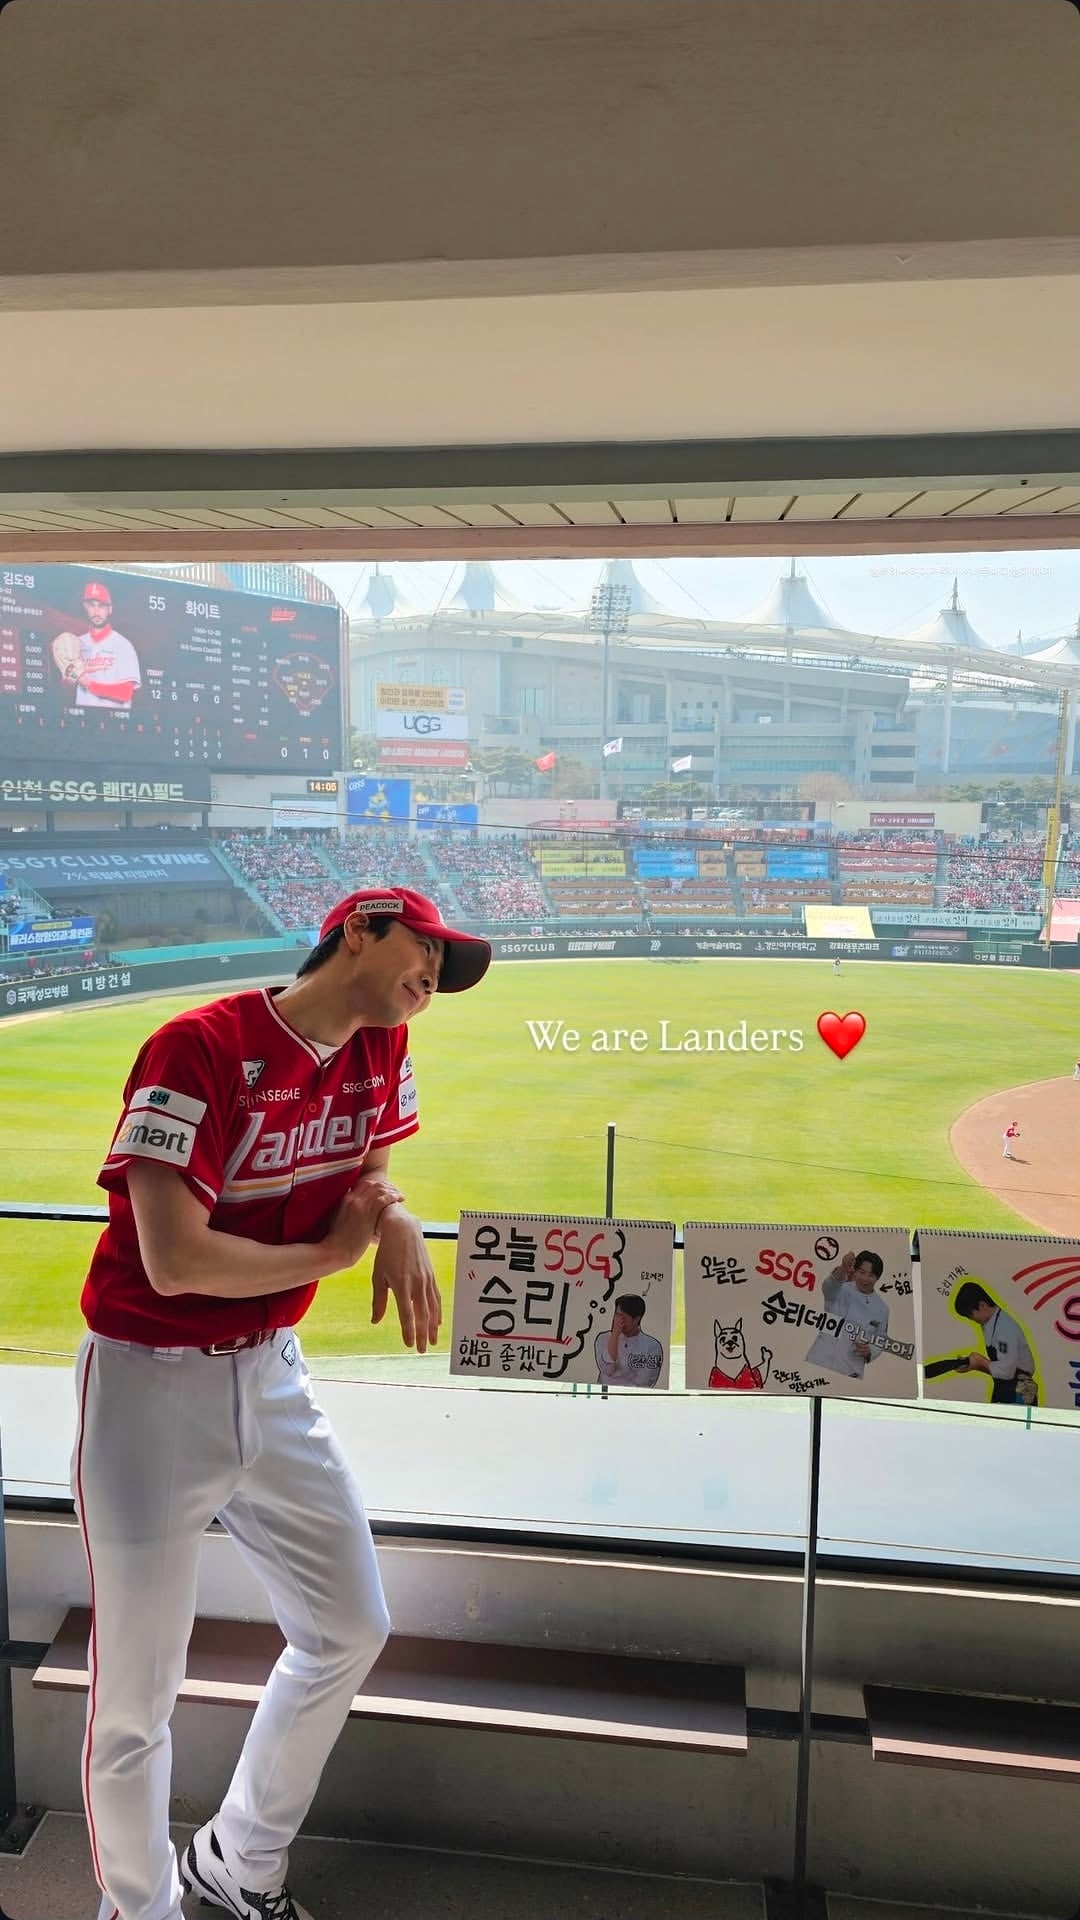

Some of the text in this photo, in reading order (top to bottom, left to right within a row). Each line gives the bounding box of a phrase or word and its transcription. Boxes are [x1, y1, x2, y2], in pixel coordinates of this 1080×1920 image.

[2, 571, 36, 589] 김도영
[148, 596, 221, 619] 55 화이트
[151, 690, 161, 699] 12
[193, 693, 199, 703] 6
[213, 695, 220, 704] 0
[403, 715, 441, 735] UGG
[281, 747, 329, 760] 0 1 0
[1, 780, 184, 802] 인천 SSG 랜더스필드
[309, 782, 337, 793] 14:05
[142, 852, 210, 865] TVING
[358, 901, 401, 912] PEACOCK
[500, 943, 556, 953] SSG7CLUB
[81, 971, 131, 992] 대방건설
[17, 984, 69, 1004] 국제성모병원
[469, 1225, 611, 1280] 오늘 SSG
[701, 1249, 816, 1292] 오늘은 SSG
[459, 1336, 559, 1372] 했음 좋겠다
